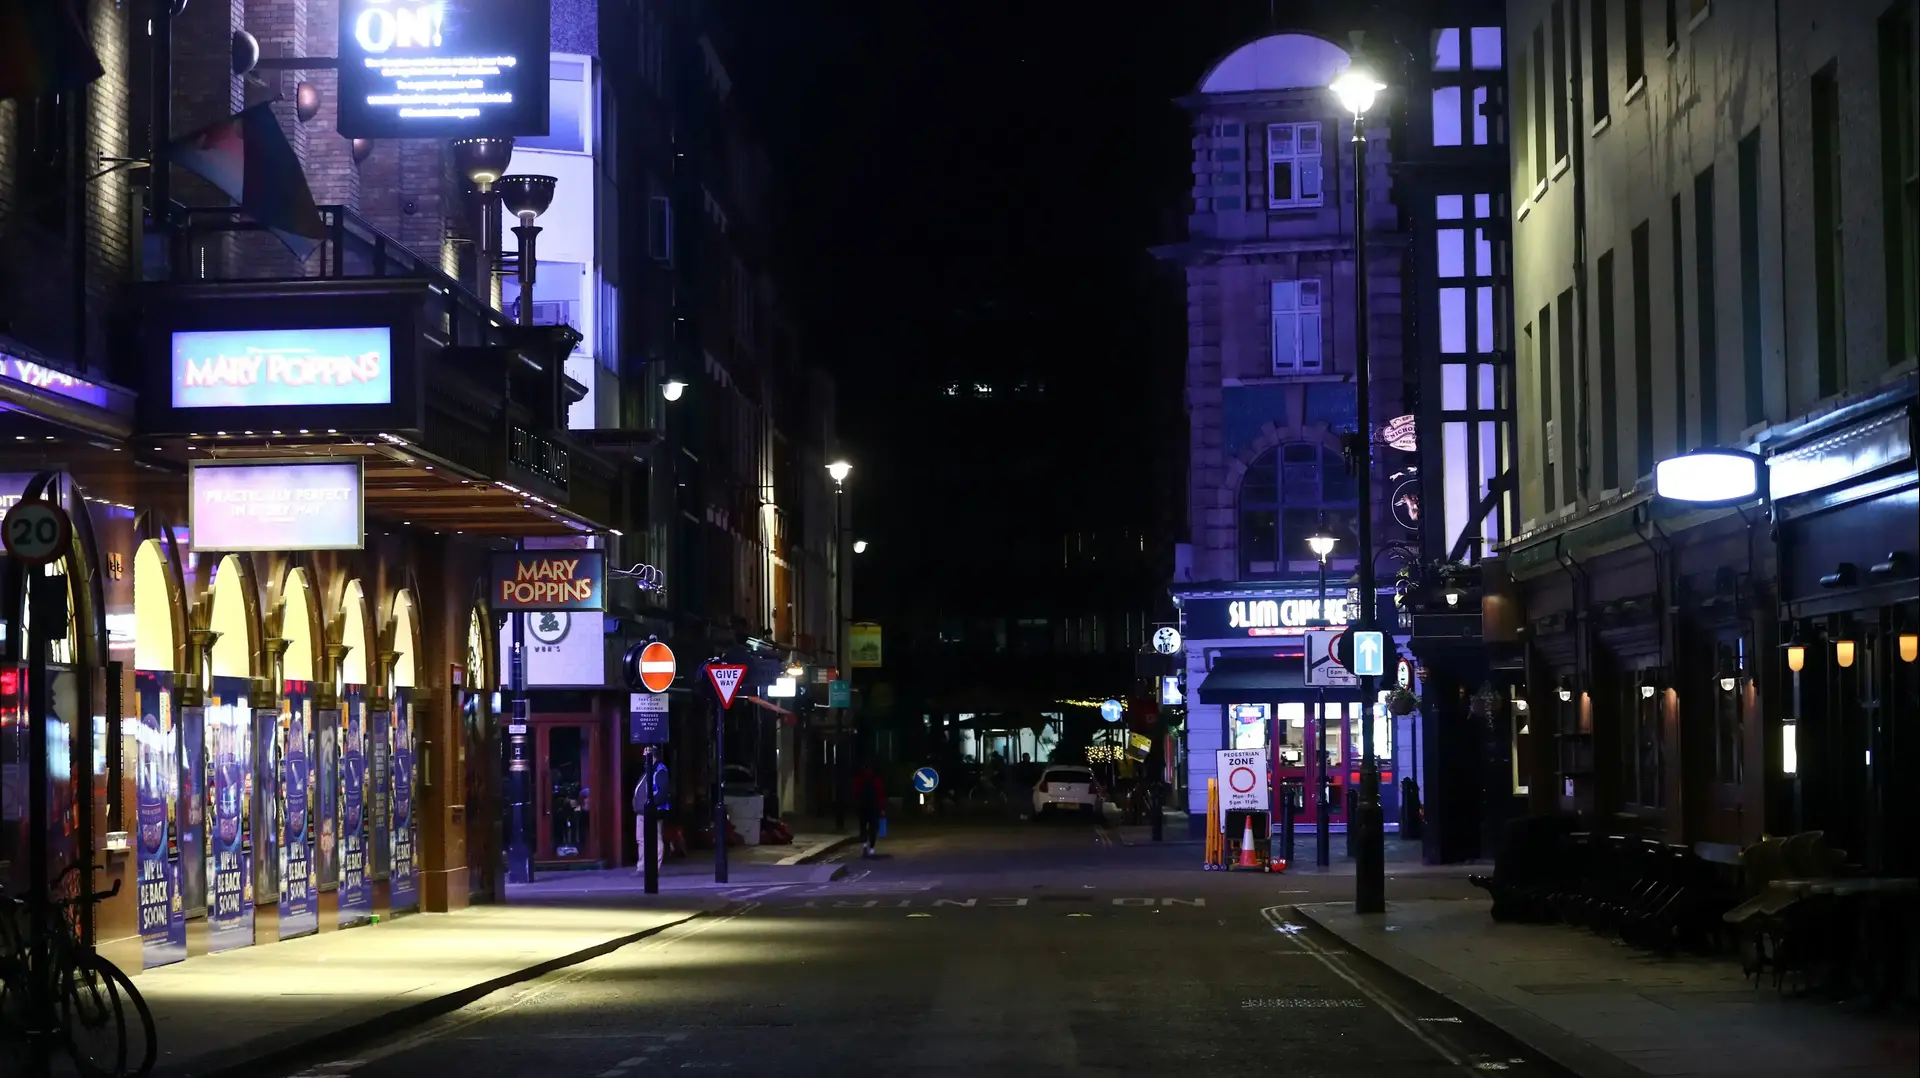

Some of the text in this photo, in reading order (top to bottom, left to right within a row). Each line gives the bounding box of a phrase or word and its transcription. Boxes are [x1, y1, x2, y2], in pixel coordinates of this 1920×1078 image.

[355, 4, 444, 54] ON!
[184, 350, 381, 387] MARY POPPINS
[296, 488, 351, 502] PERFECT
[233, 503, 248, 518] IN
[12, 515, 58, 545] 20
[517, 557, 579, 581] MARY
[503, 578, 591, 603] POPPINS
[1229, 600, 1279, 628] SLIM
[715, 670, 738, 679] GIVE
[1229, 758, 1254, 766] ZONE
[220, 851, 238, 870] WE'LL
[290, 841, 305, 860] WE'LL
[144, 860, 164, 880] WE'LL
[288, 860, 307, 881] BE BACK
[217, 871, 241, 893] BE BACK
[290, 881, 307, 901] SOON!
[141, 884, 150, 905] BE
[150, 881, 168, 904] BACK
[1112, 897, 1206, 906] NO
[218, 893, 240, 915] SOON!
[143, 905, 168, 929] SOON!
